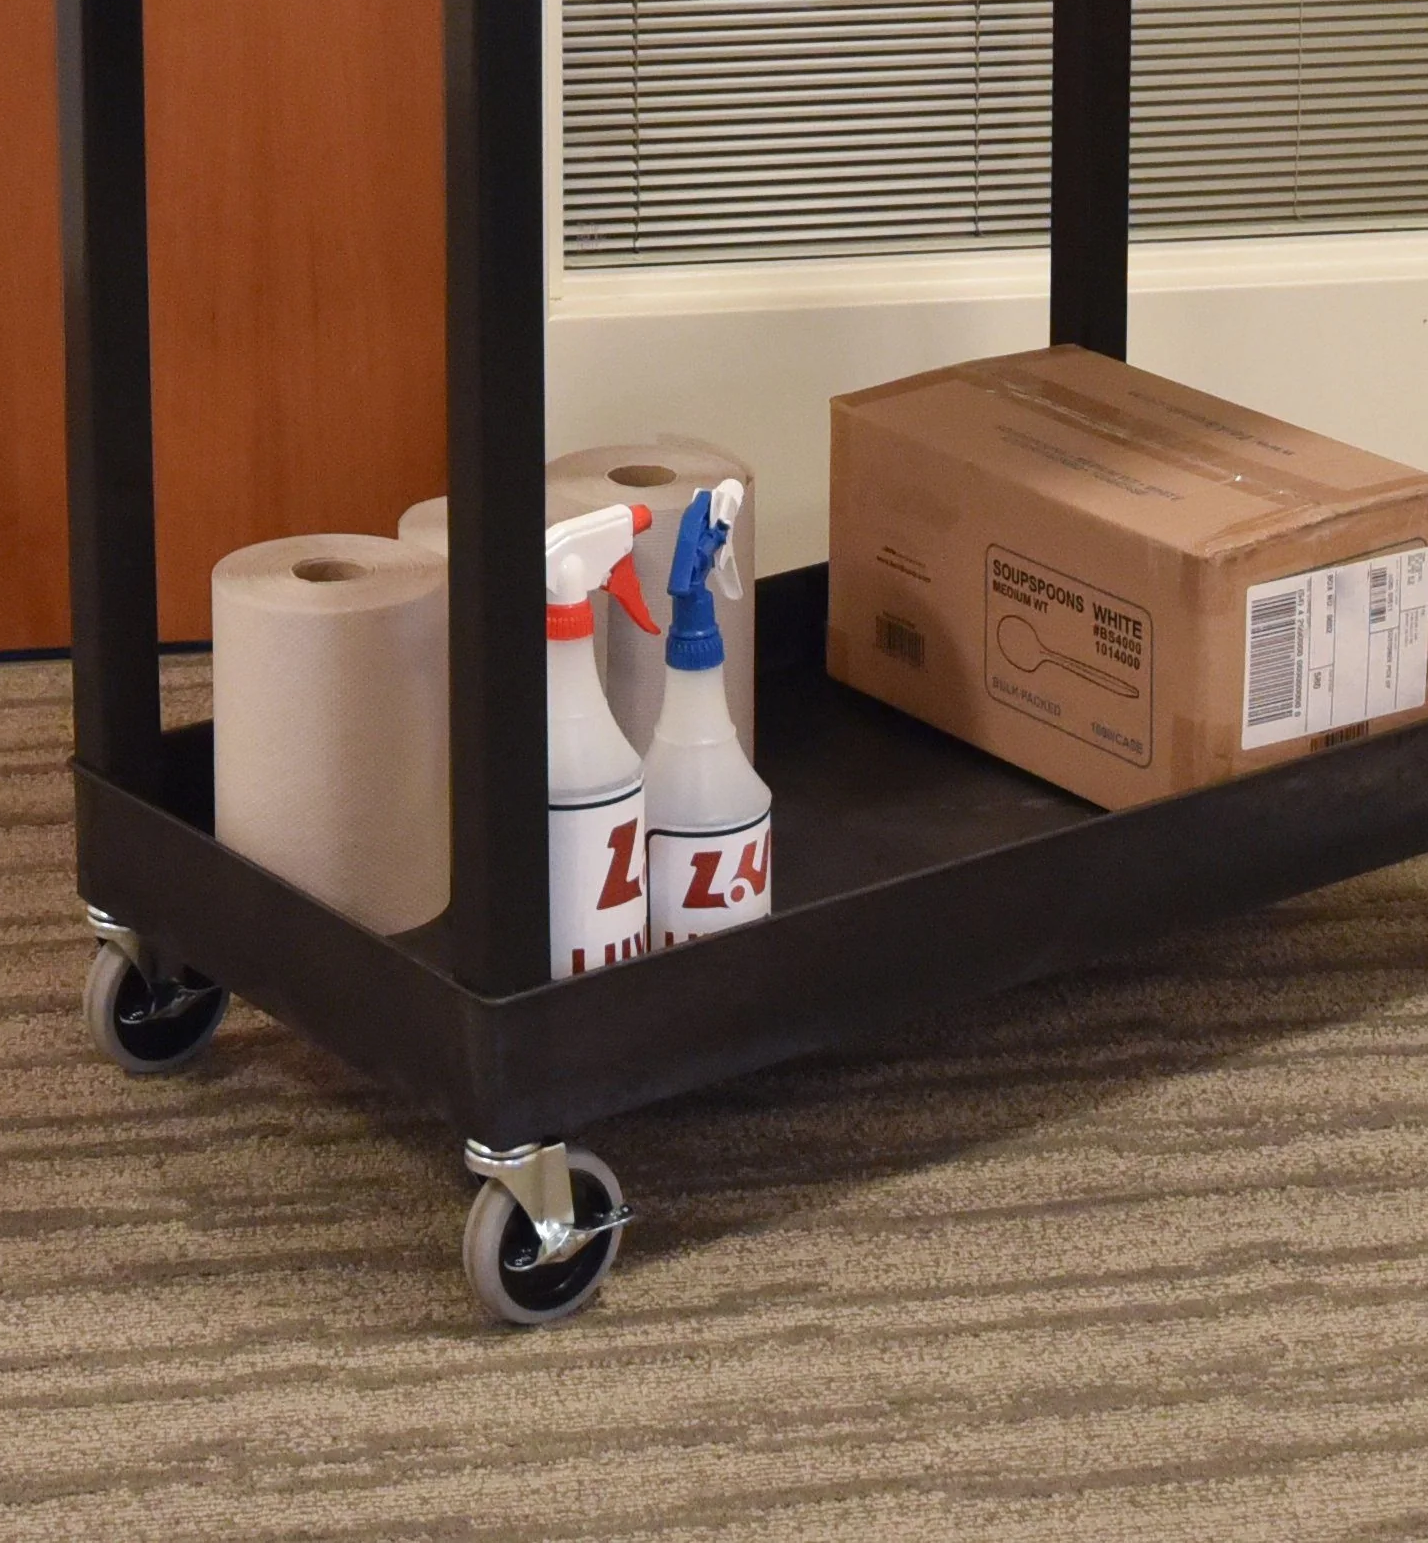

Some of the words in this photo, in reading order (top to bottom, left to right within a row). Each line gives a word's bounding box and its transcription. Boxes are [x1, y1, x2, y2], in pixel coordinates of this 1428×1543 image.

[992, 579, 1032, 607] MEDIUM
[1033, 599, 1049, 614] WT
[992, 558, 1085, 613] SOUPSPOONS
[1092, 602, 1143, 640] WHITE
[1093, 624, 1142, 656] #BS4000
[1095, 641, 1141, 670] 1014000
